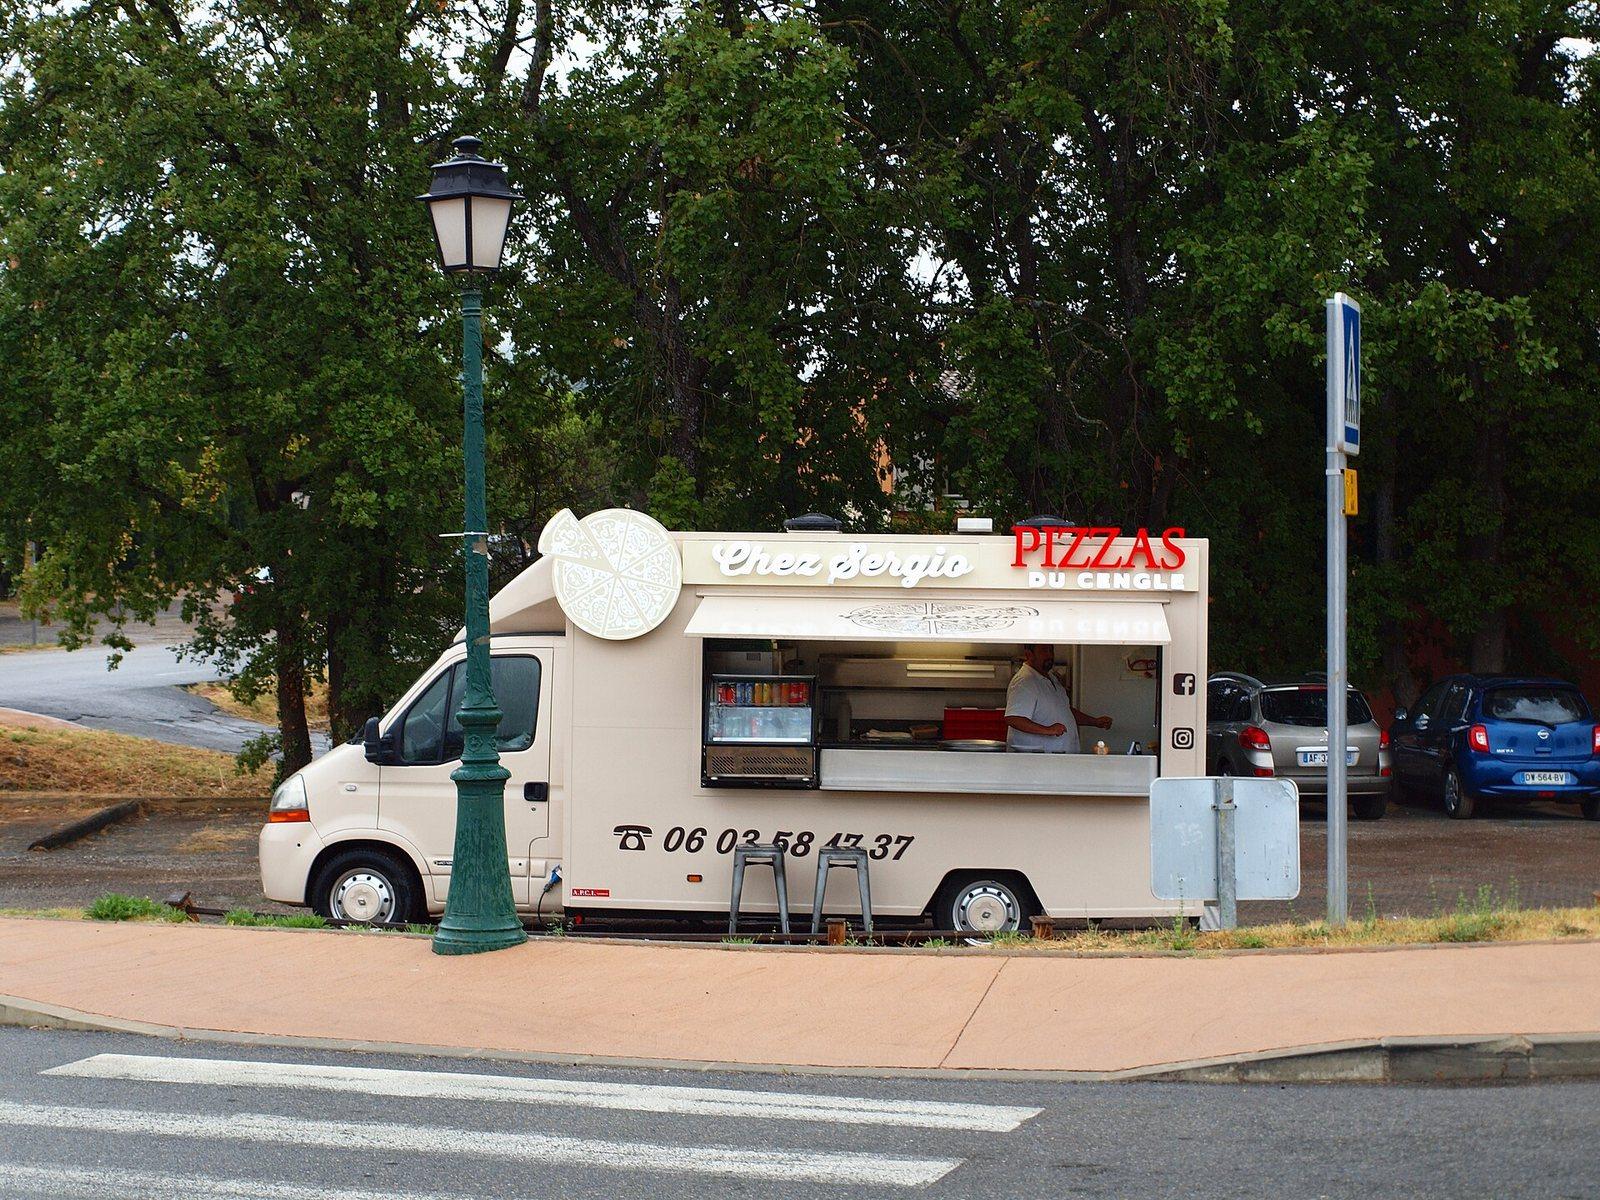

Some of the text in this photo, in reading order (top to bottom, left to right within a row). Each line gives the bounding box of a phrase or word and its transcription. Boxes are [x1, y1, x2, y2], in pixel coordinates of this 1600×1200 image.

[711, 541, 974, 588] Chez Sergio
[1011, 525, 1187, 570] PIZZAS
[1028, 571, 1185, 590] DU CENGLE
[663, 826, 707, 853] 06
[716, 828, 760, 855] 03
[772, 830, 815, 857] 58
[869, 834, 915, 861] 37
